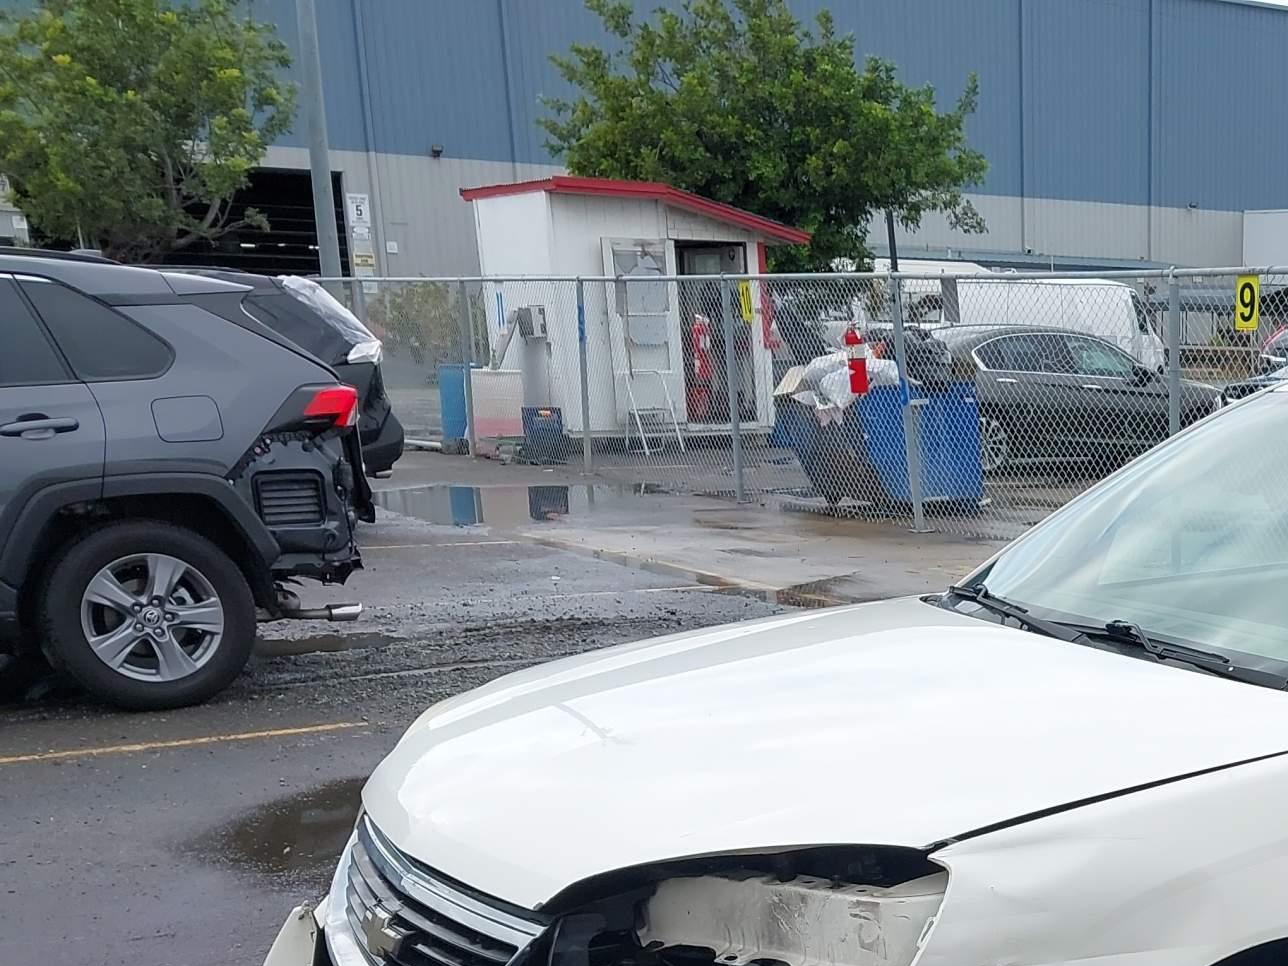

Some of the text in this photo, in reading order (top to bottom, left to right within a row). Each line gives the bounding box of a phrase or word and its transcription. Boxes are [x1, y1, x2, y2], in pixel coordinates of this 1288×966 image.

[355, 204, 363, 217] 5
[741, 285, 752, 315] 10
[1239, 282, 1256, 322] 9
